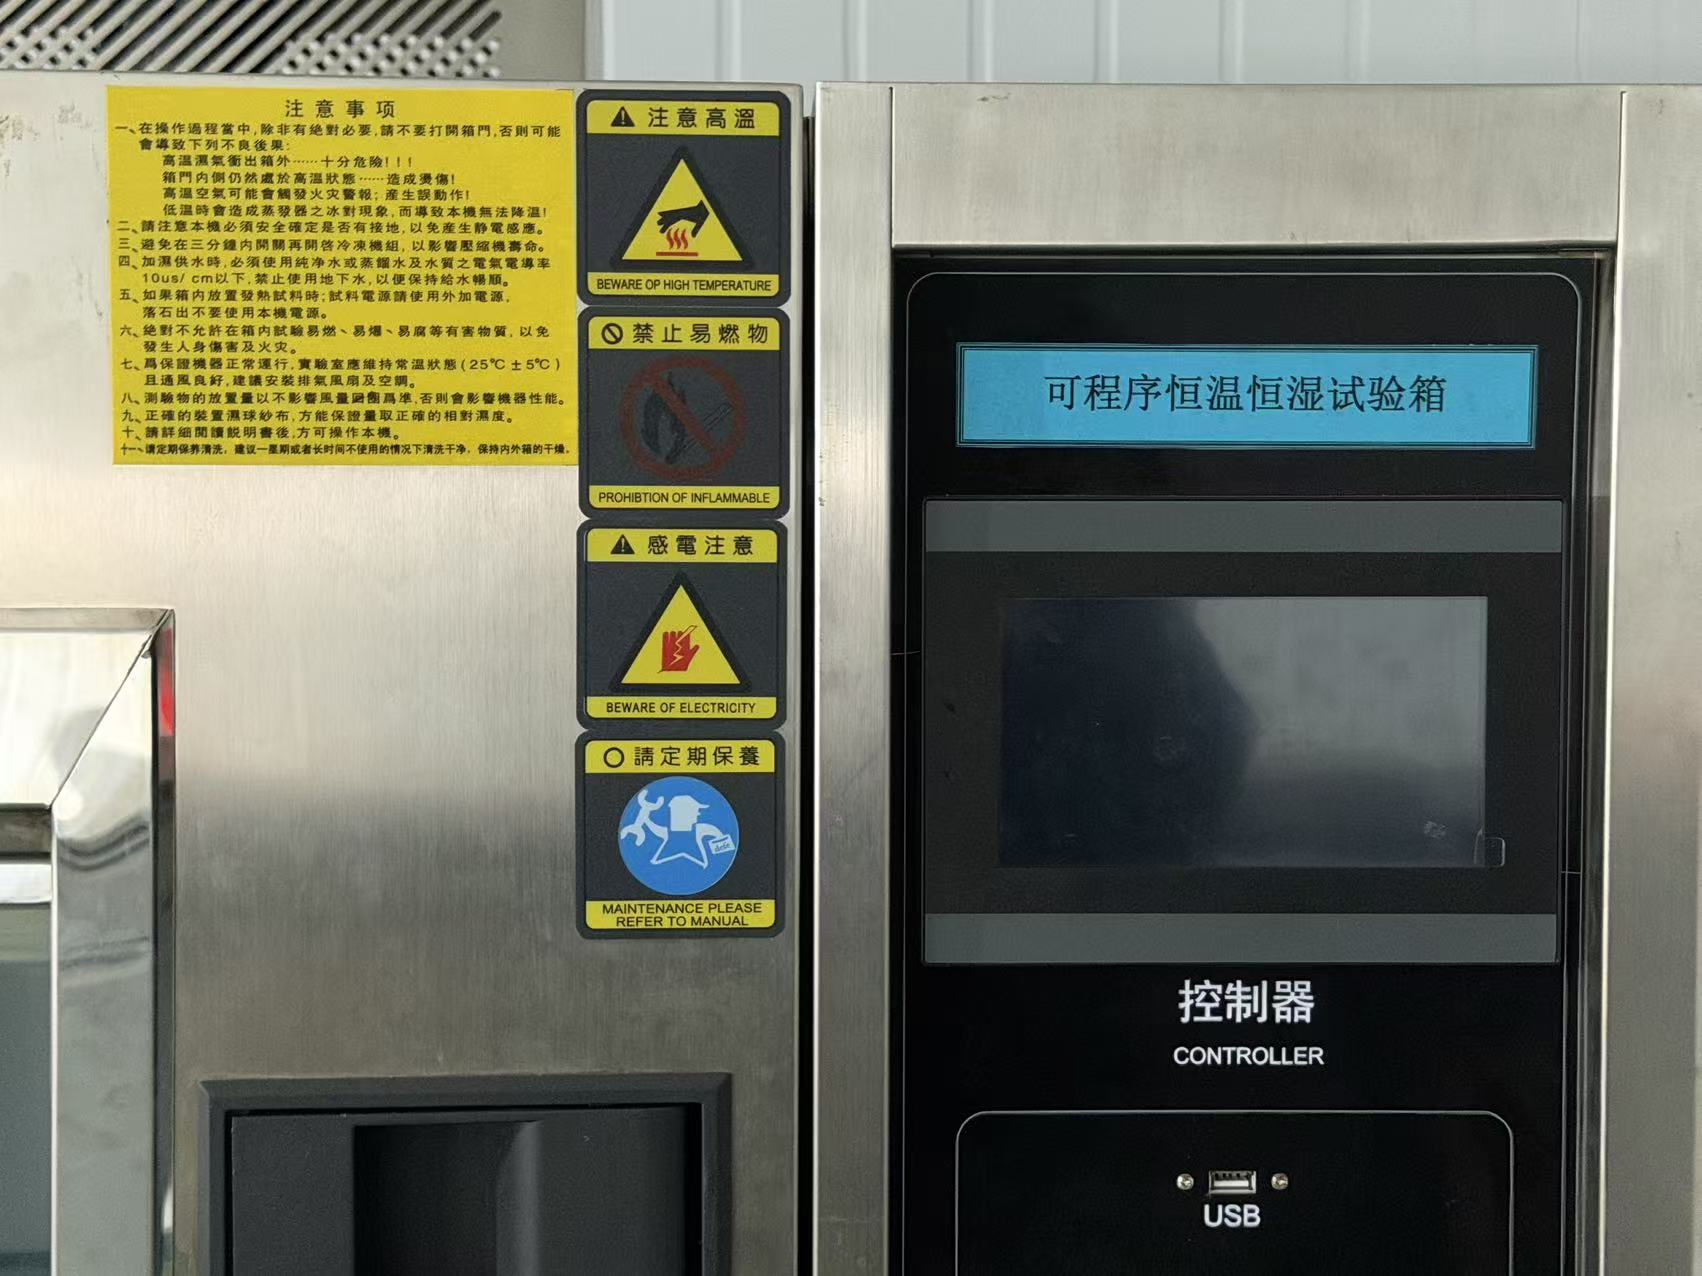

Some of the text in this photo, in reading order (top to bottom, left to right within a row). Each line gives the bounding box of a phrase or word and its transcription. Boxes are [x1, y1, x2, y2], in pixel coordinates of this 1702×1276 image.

[285, 99, 395, 118] 注意事项
[597, 279, 643, 290] BEWARE
[663, 280, 690, 291] HIGH
[693, 280, 772, 292] TEMPERATURE
[633, 323, 768, 344] 禁止易燃物
[1044, 373, 1447, 413] 可程序恒温恒湿试验箱
[598, 492, 770, 504] PROHIBTION OF INFLAMMABLE
[647, 535, 753, 556] 感電注意
[606, 702, 756, 714] BEWARE OF ELECTRICITY
[634, 746, 760, 767] 請定期保養
[602, 903, 762, 914] MAINTENANCE PLEASE
[616, 916, 749, 927] REFER TO MANUAL
[1178, 979, 1315, 1024] 控制器
[1173, 1046, 1325, 1066] CONTROLLER
[1203, 1203, 1261, 1228] USB
